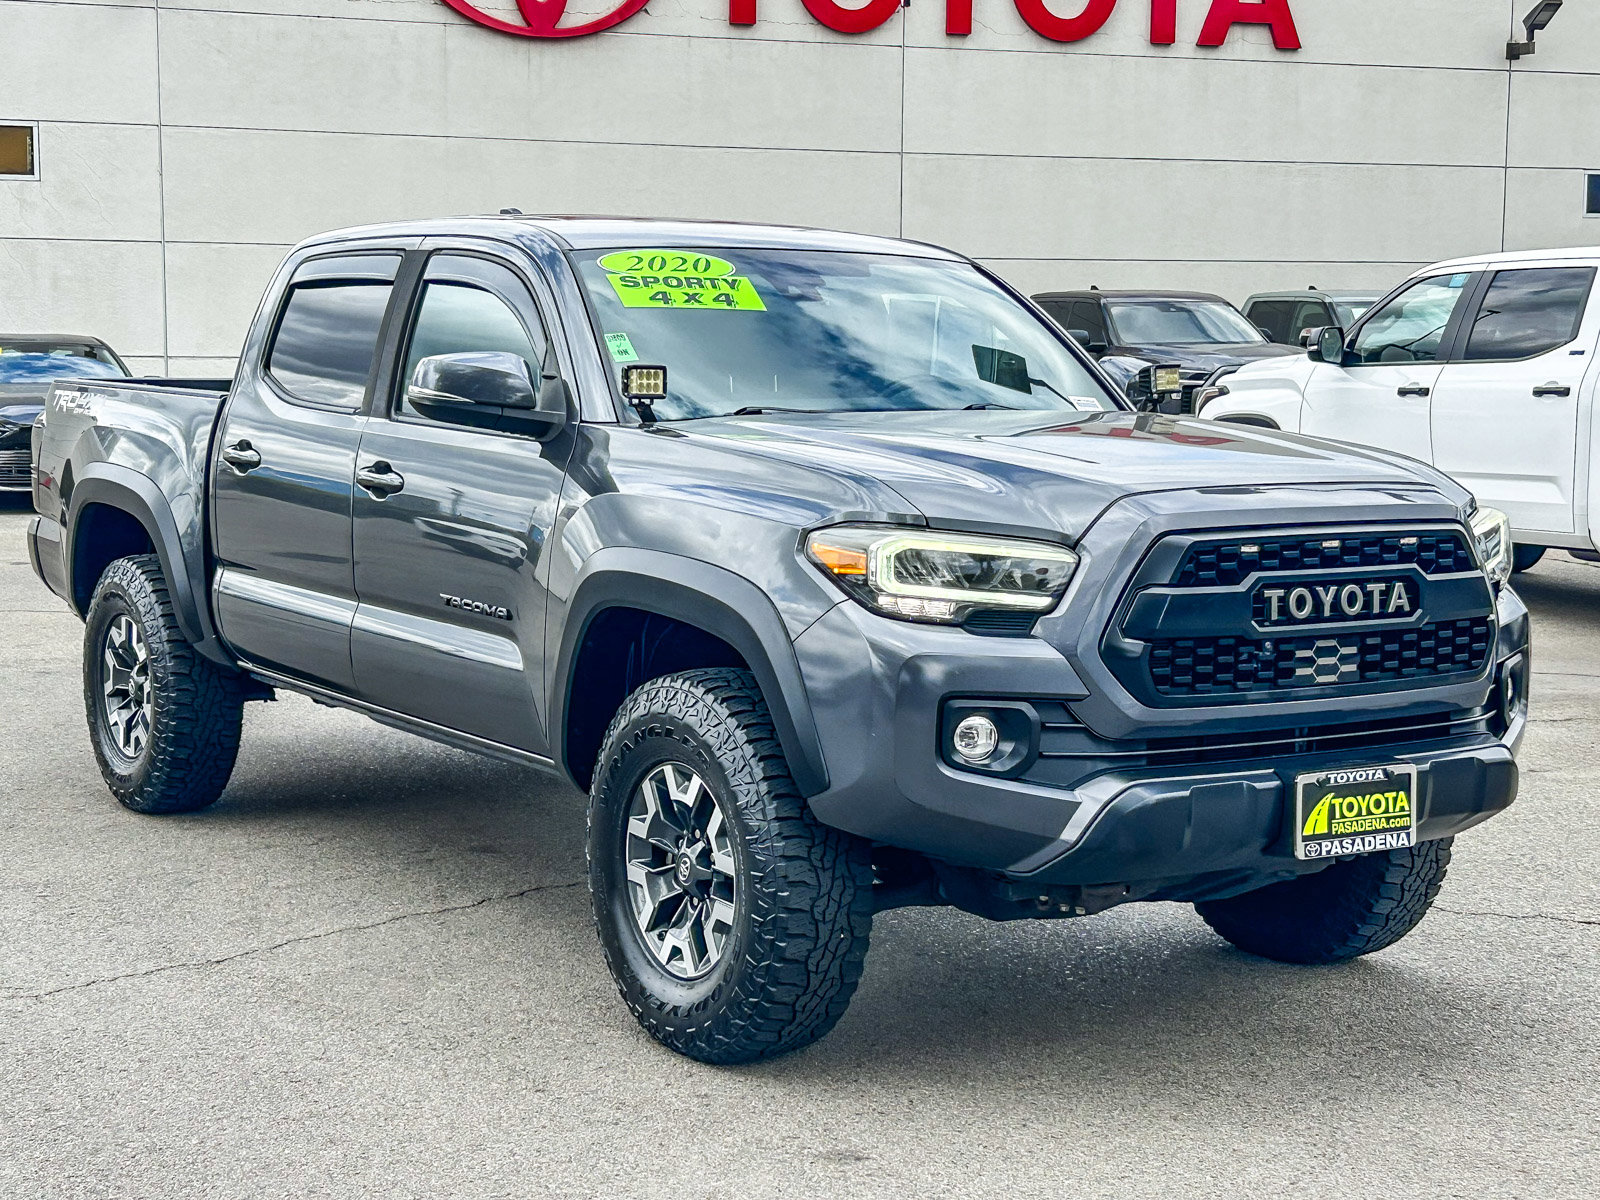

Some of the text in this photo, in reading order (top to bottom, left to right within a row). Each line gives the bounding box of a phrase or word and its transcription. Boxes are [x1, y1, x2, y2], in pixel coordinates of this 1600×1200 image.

[626, 255, 712, 273] 2020
[619, 275, 742, 291] SPORTY
[53, 389, 81, 412] TRD
[439, 593, 511, 620] TACOMA
[1264, 582, 1411, 621] TOYOTA
[1327, 769, 1385, 784] TOYOTA
[1331, 791, 1410, 819] TOYOTA
[1331, 817, 1411, 835] PASADENA.com
[1321, 832, 1410, 856] PASADENA
